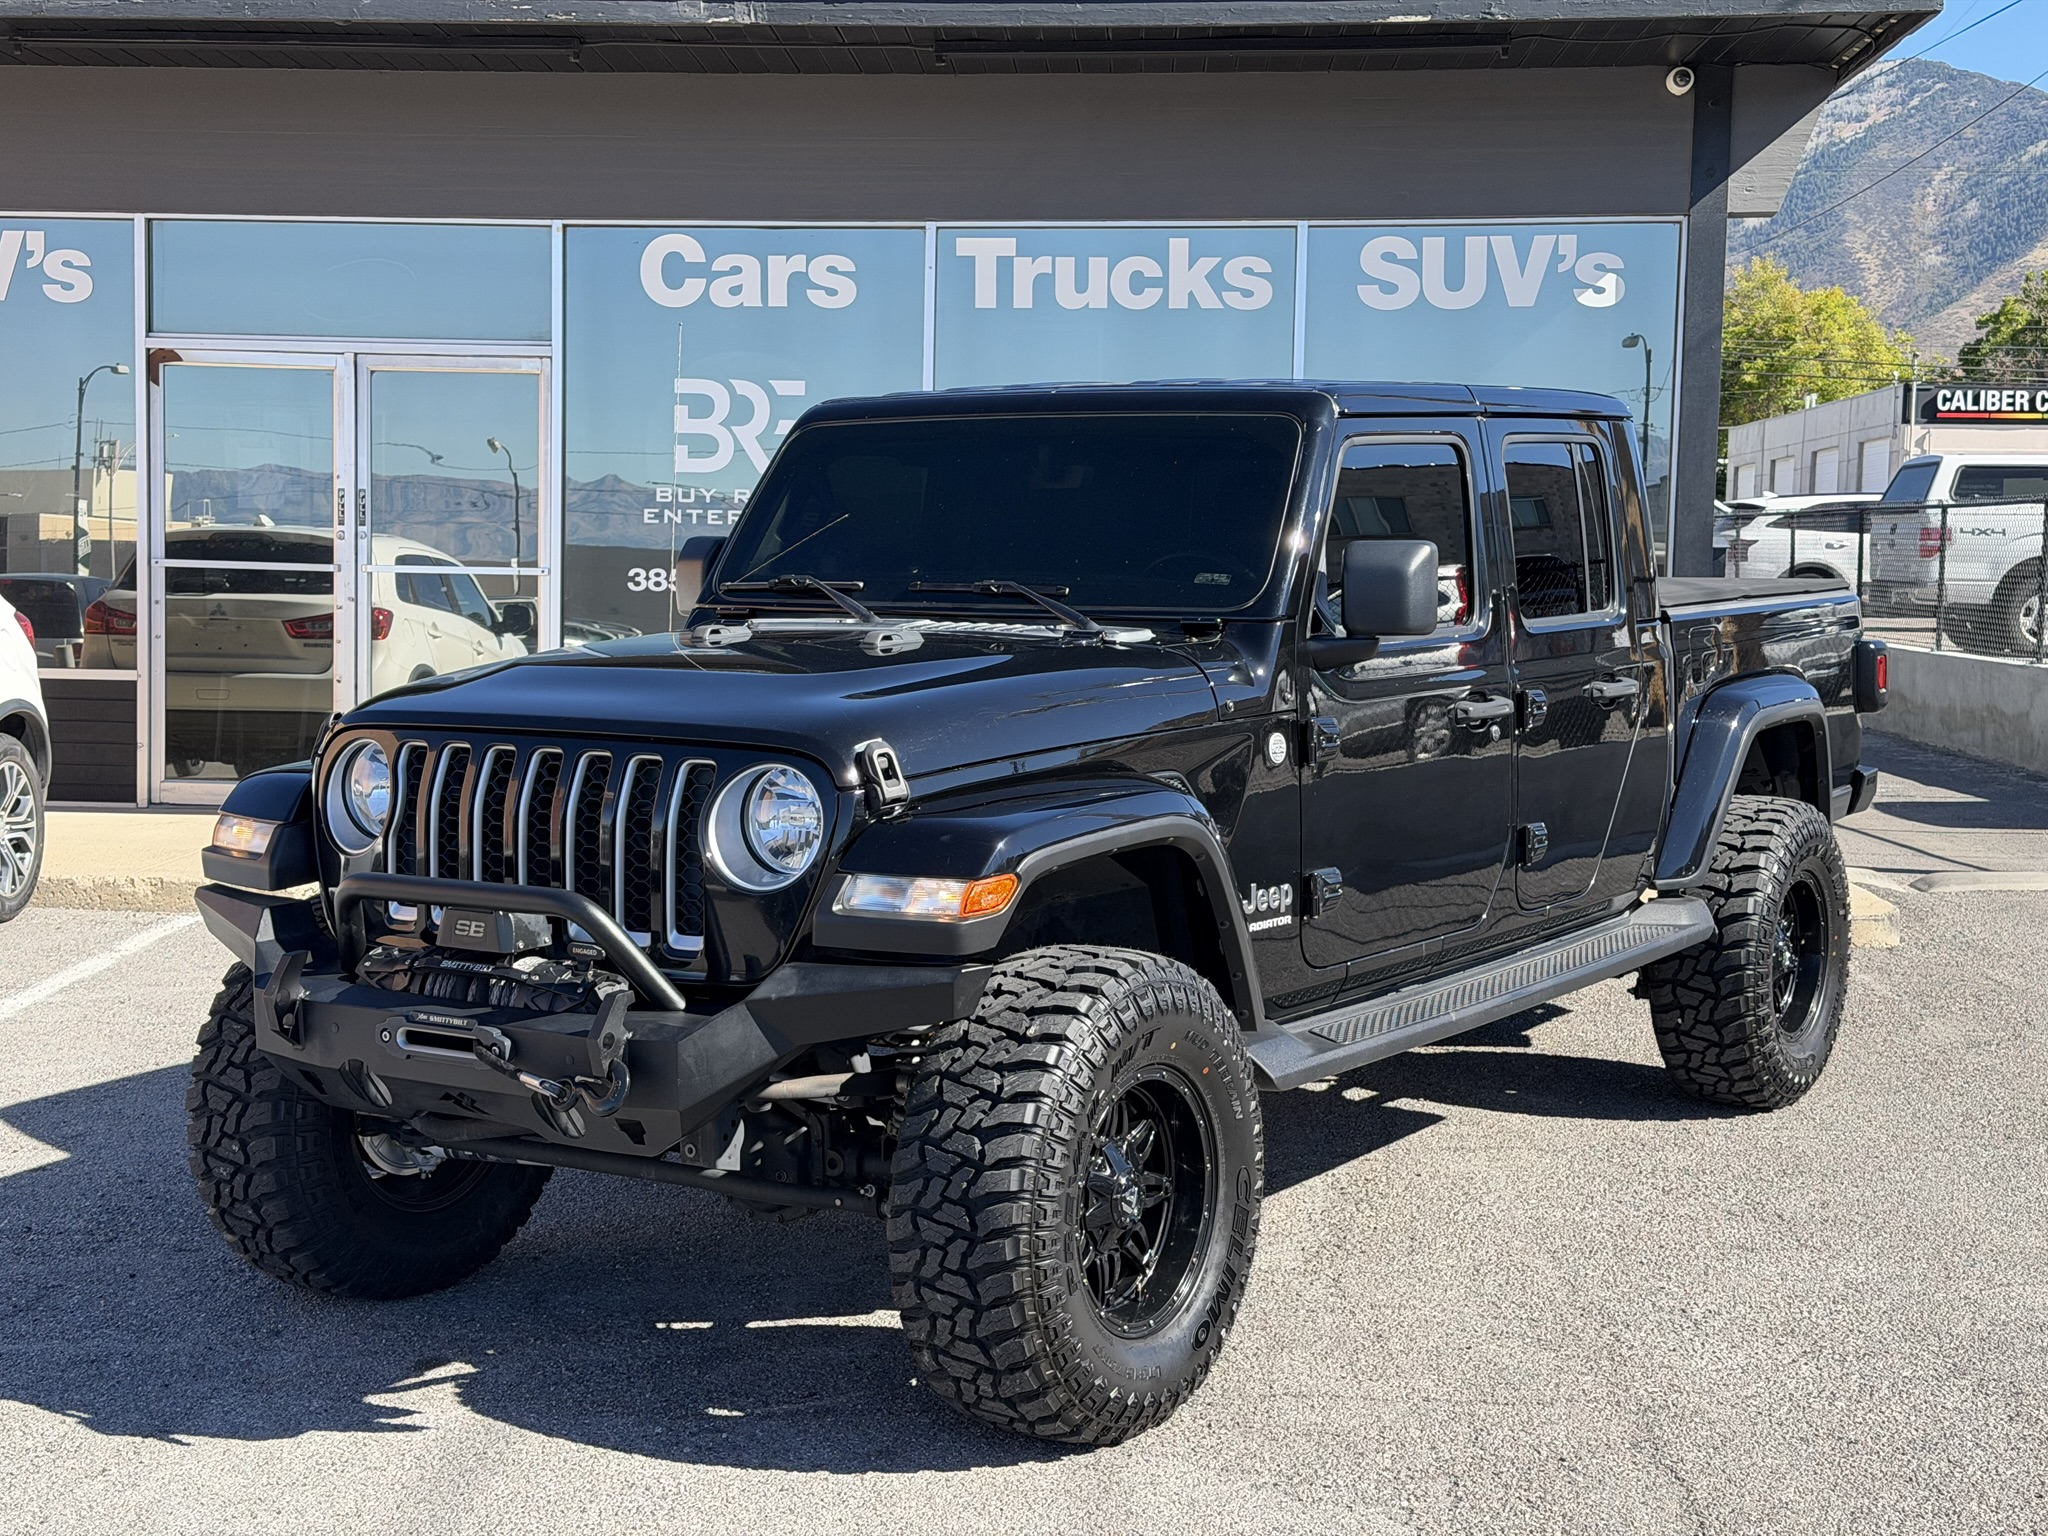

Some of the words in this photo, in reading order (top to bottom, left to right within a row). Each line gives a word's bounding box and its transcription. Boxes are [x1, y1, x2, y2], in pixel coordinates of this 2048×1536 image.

[639, 233, 857, 309] Cars
[955, 237, 1273, 311] Trucks
[1356, 234, 1625, 311] SUV's
[1937, 389, 2030, 411] CALIBER
[655, 487, 717, 503] BUY
[1242, 883, 1293, 914] Jeep
[440, 960, 495, 972] SMITTYBILT
[572, 947, 598, 956] ENGAGED
[1191, 1165, 1252, 1352] CELIMO
